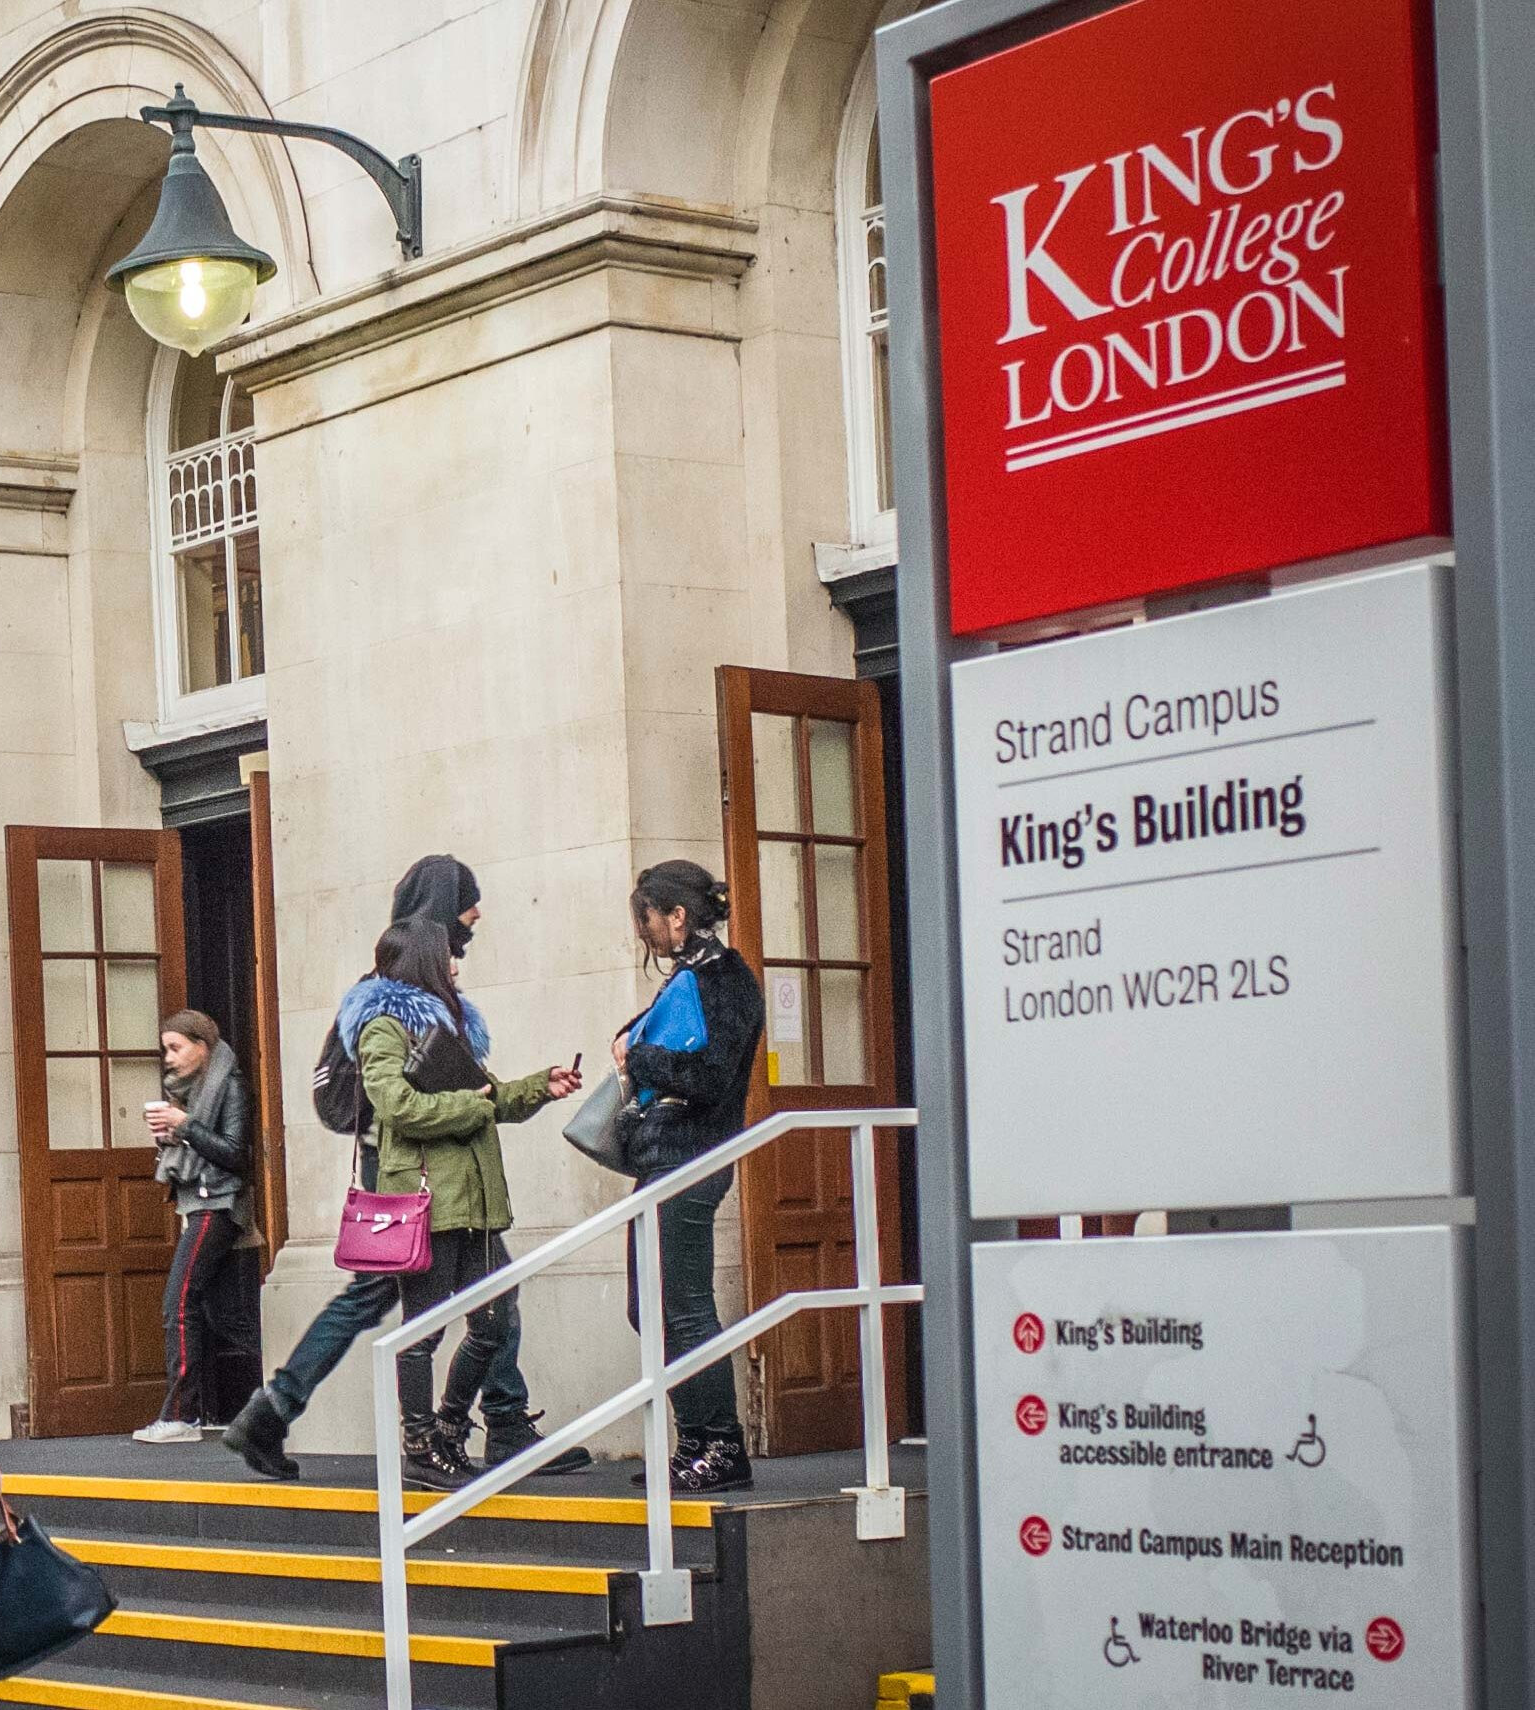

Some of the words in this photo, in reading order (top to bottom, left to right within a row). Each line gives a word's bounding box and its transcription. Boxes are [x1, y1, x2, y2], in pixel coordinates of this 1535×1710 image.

[990, 82, 1344, 345] KING'S
[1110, 190, 1346, 310] College
[1002, 266, 1350, 430] LONDON
[995, 700, 1112, 763] Strand
[1125, 679, 1280, 736] Campus
[1000, 802, 1118, 869] King's
[1133, 775, 1307, 848] Building
[1002, 919, 1102, 966] Strand
[1004, 980, 1113, 1023] London
[1123, 963, 1219, 1010] WC2R
[1230, 954, 1290, 1000] 2LS
[1055, 1318, 1115, 1350] King's
[1121, 1317, 1204, 1350] Building
[1058, 1403, 1118, 1434] King's
[1124, 1403, 1207, 1435] Building
[1059, 1440, 1167, 1467] accessible
[1173, 1442, 1273, 1470] entrance
[1062, 1525, 1133, 1554] Strand
[1139, 1529, 1224, 1561] Campus
[1230, 1532, 1283, 1561] Main
[1289, 1534, 1404, 1569] Reception
[1138, 1612, 1233, 1646] Waterloo
[1240, 1619, 1312, 1654] Bridge
[1318, 1625, 1353, 1654] via
[1202, 1653, 1259, 1684] River
[1265, 1657, 1355, 1692] Terrace
